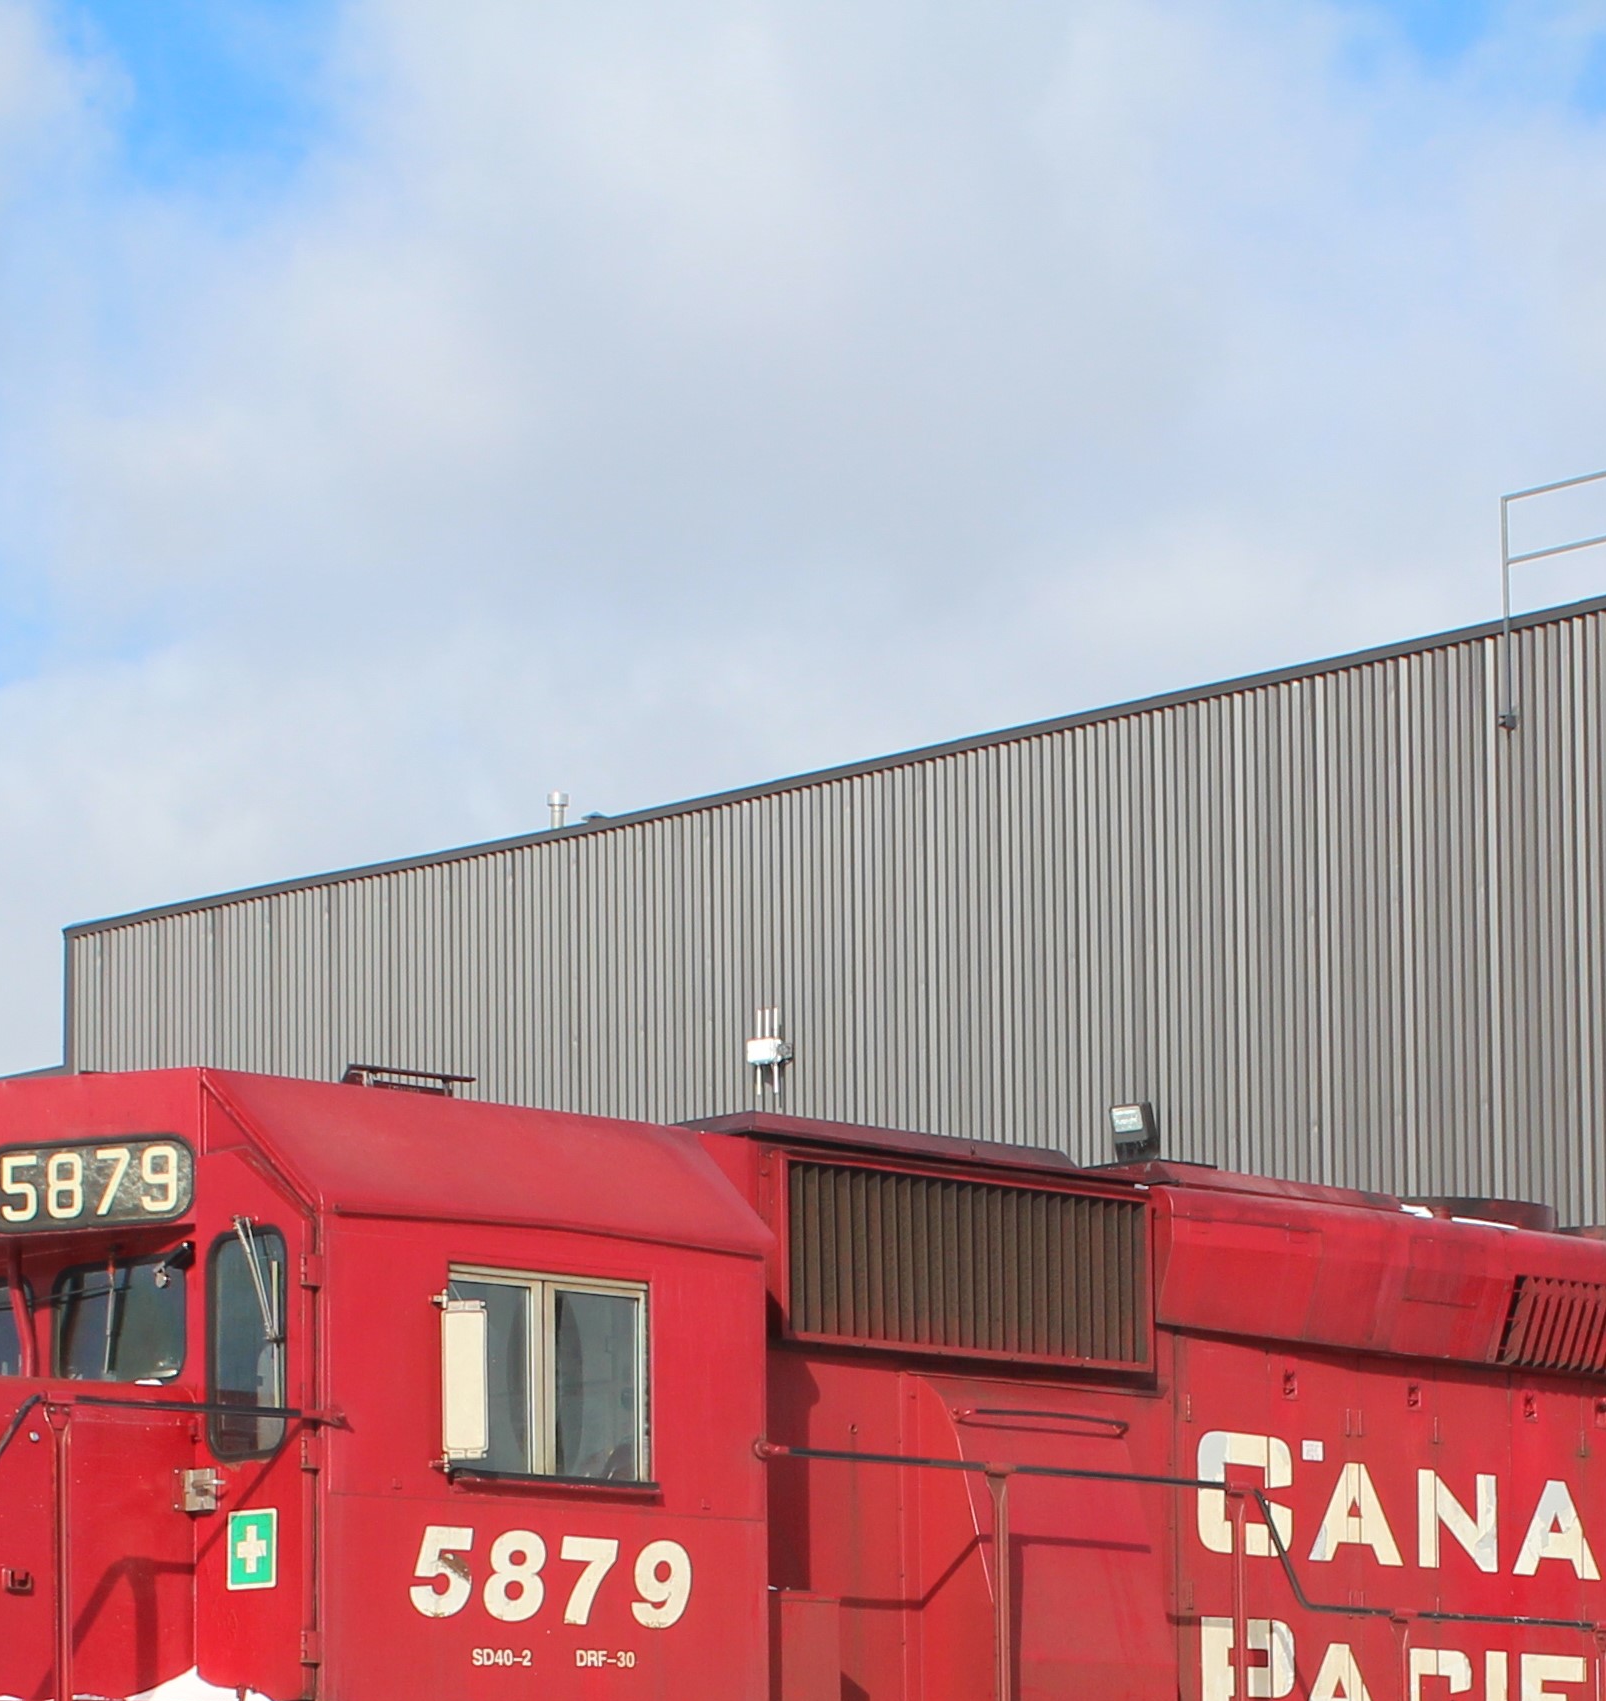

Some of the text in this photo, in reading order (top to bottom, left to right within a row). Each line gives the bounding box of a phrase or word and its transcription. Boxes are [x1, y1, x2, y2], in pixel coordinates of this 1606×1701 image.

[0, 1145, 179, 1223] 5879
[409, 1525, 693, 1629] 5879
[472, 1648, 636, 1668] SD40-2 DRF-30
